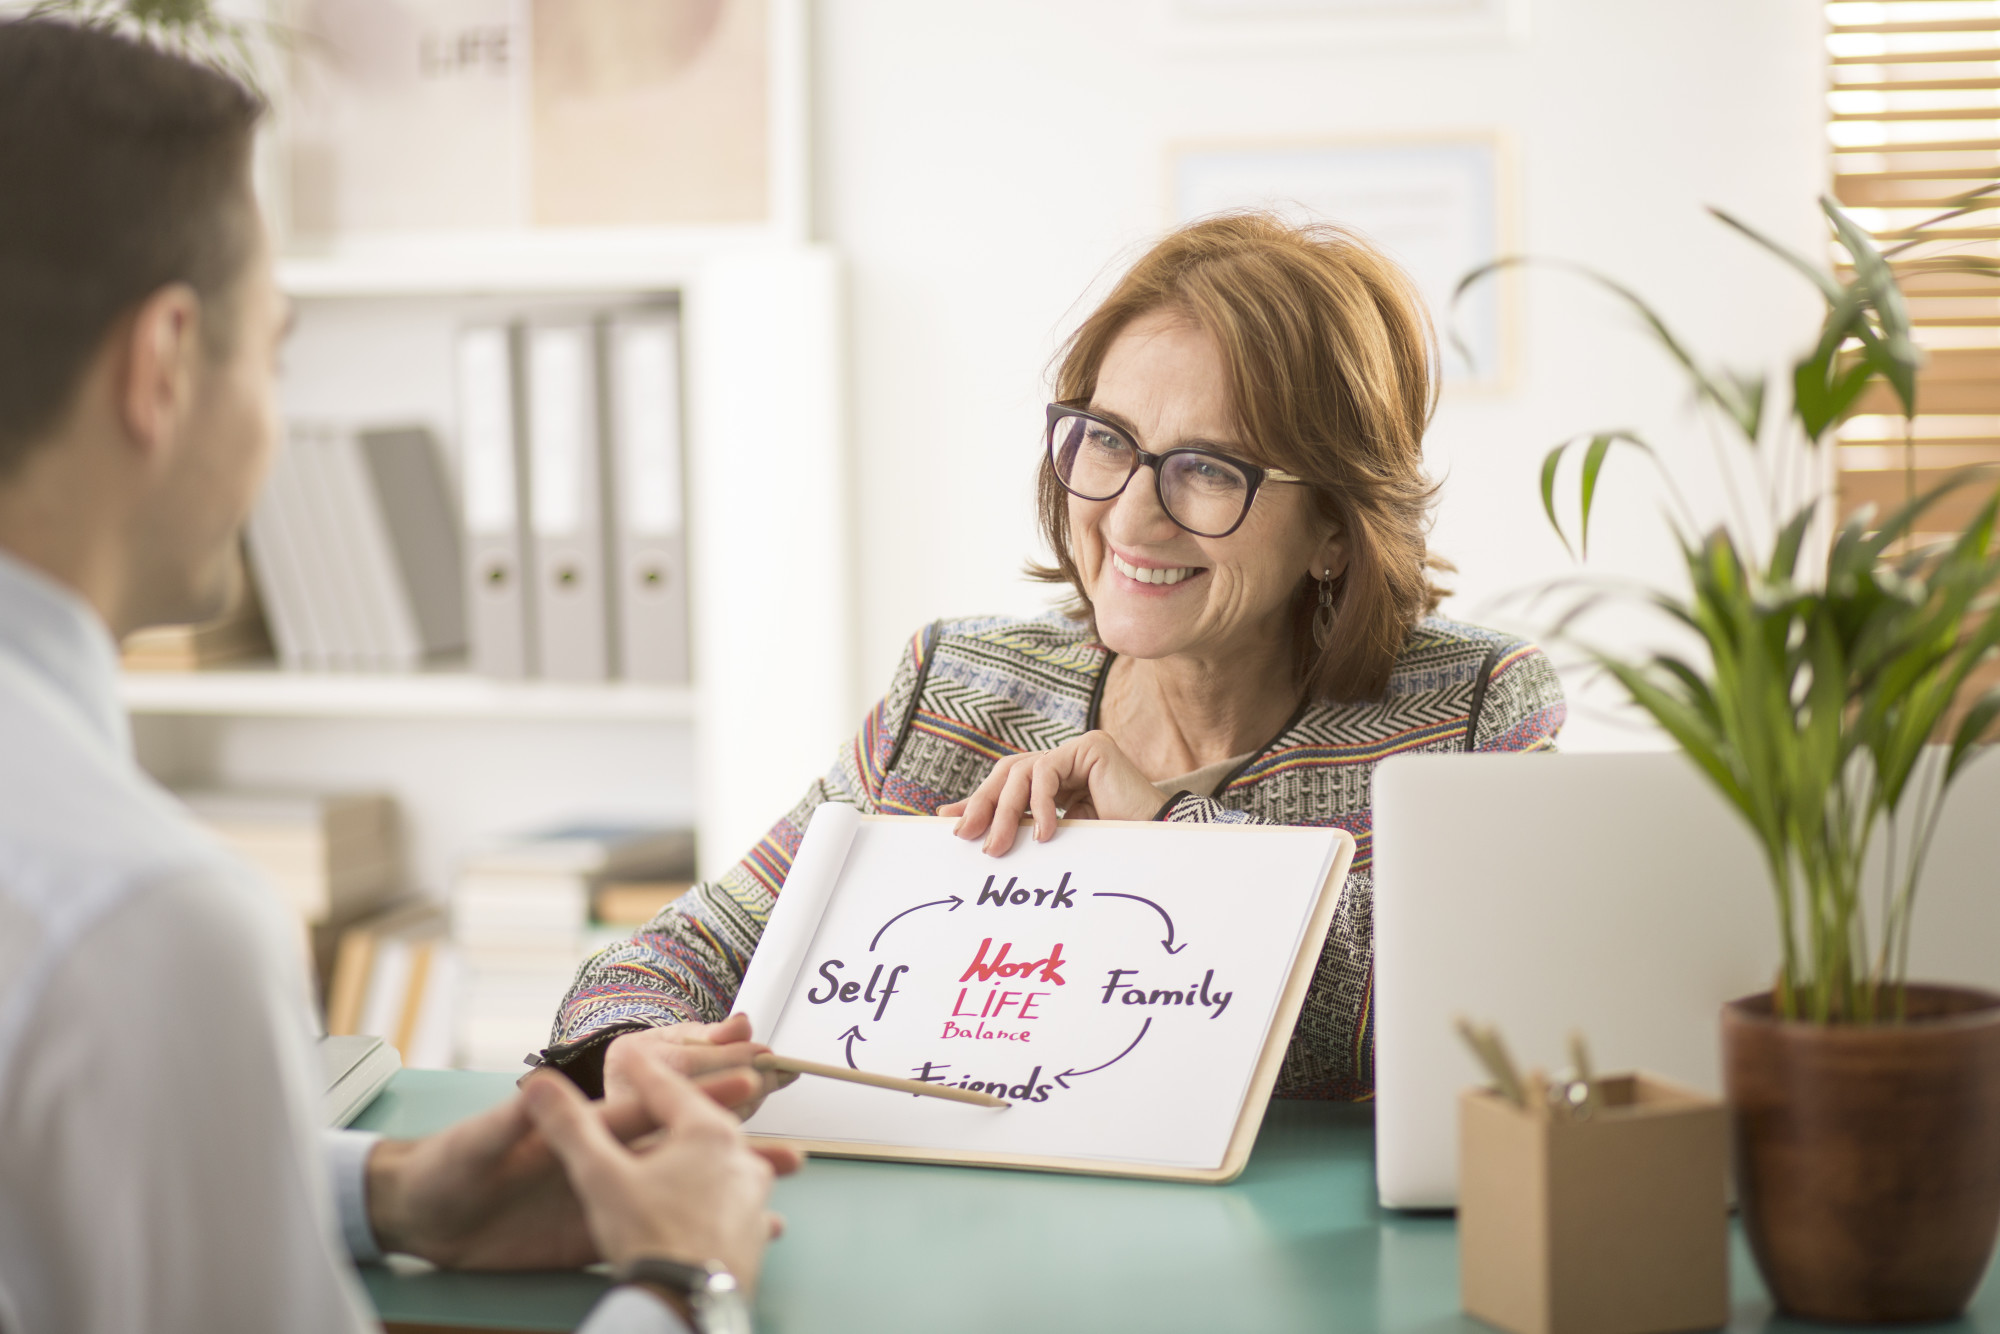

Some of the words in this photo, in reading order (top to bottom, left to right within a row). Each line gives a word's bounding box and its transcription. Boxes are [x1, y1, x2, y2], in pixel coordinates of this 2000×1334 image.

[976, 871, 1078, 909] Work
[958, 937, 1067, 986] Work
[807, 959, 910, 1022] Self
[1101, 968, 1234, 1020] Family
[940, 1020, 1031, 1043] Balance
[910, 1061, 1054, 1102] Fiends
